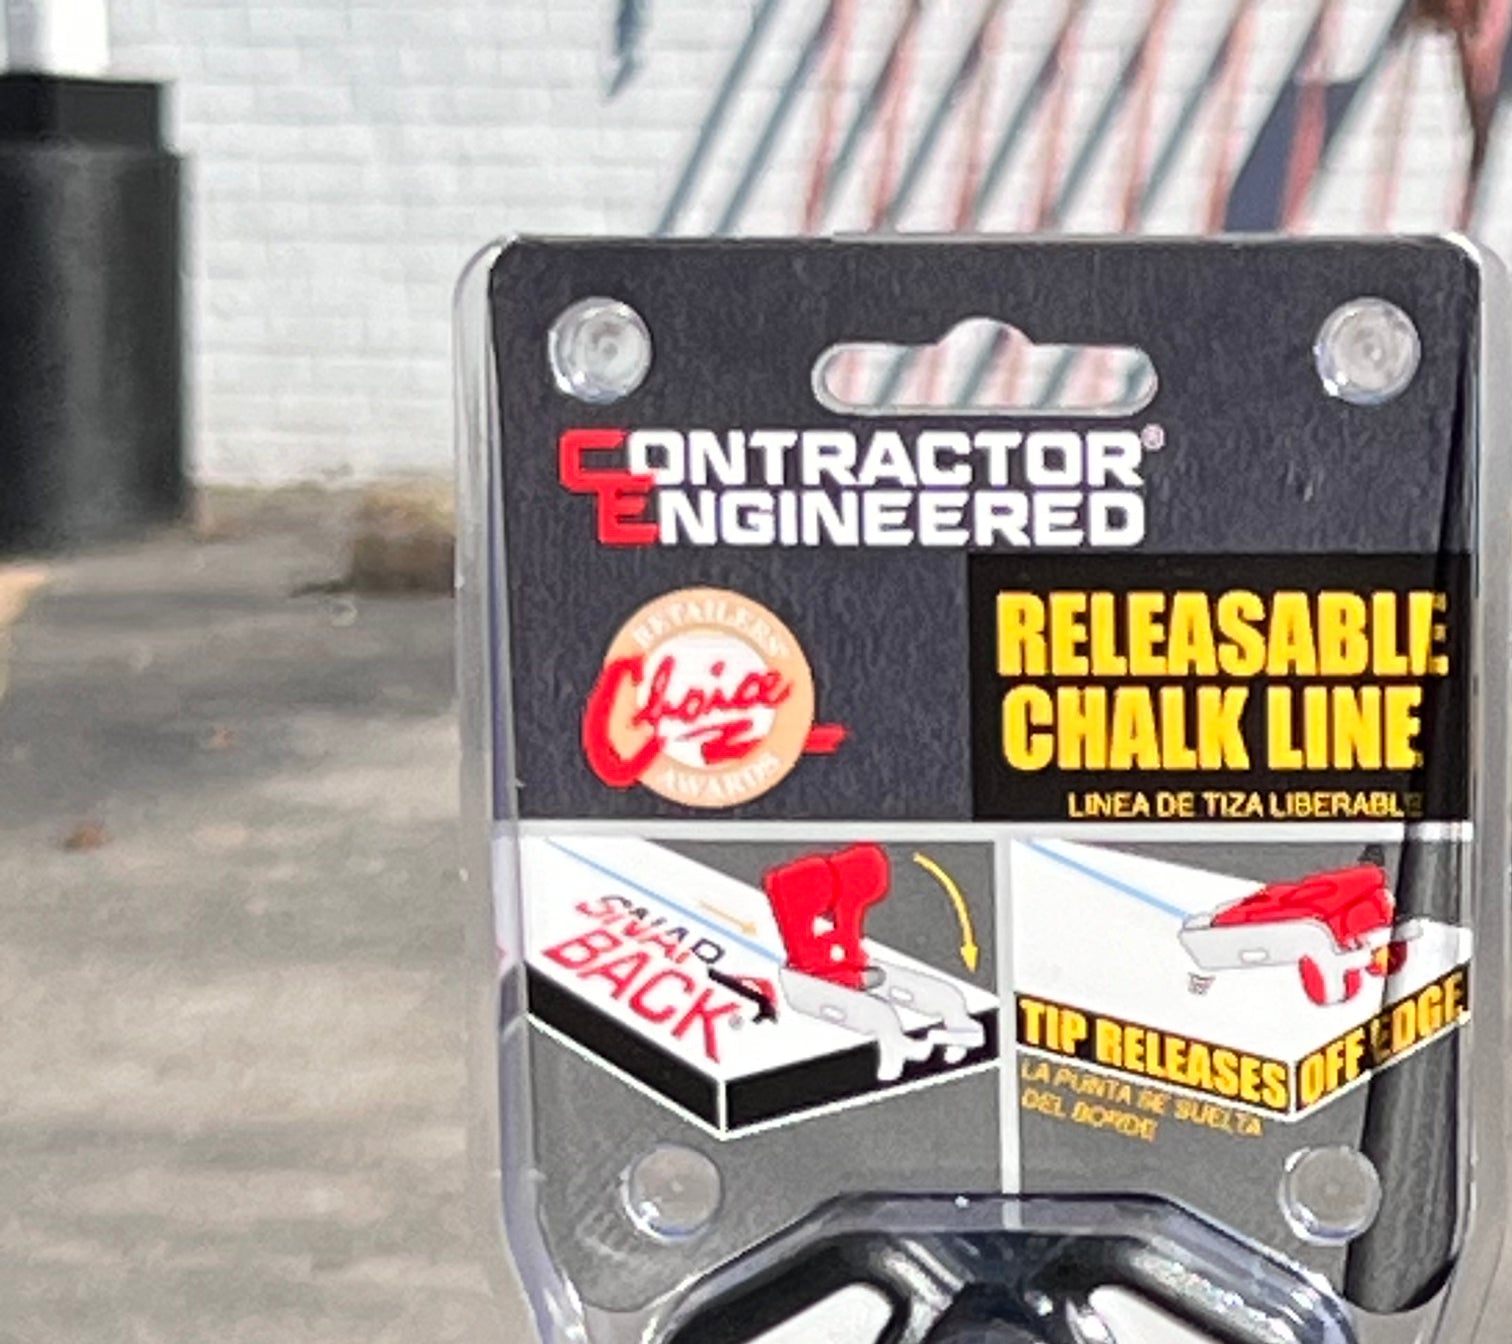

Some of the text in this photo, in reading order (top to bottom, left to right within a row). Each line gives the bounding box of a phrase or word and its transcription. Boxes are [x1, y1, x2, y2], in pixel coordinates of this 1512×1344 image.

[558, 428, 1144, 490] CONTRACTOR
[597, 484, 1146, 546] ENGINEERED
[997, 590, 1449, 677] RELEASABLE
[1002, 684, 1423, 771] CHALK LINE
[1157, 792, 1193, 818] DE
[1204, 792, 1264, 818] TIZA
[542, 928, 740, 1063] BACK
[1019, 998, 1087, 1054] TIP
[1096, 1018, 1289, 1110] RELEASES
[1300, 1035, 1366, 1105] OFF
[1022, 1062, 1050, 1085] LA
[1022, 1089, 1066, 1119] DEL
